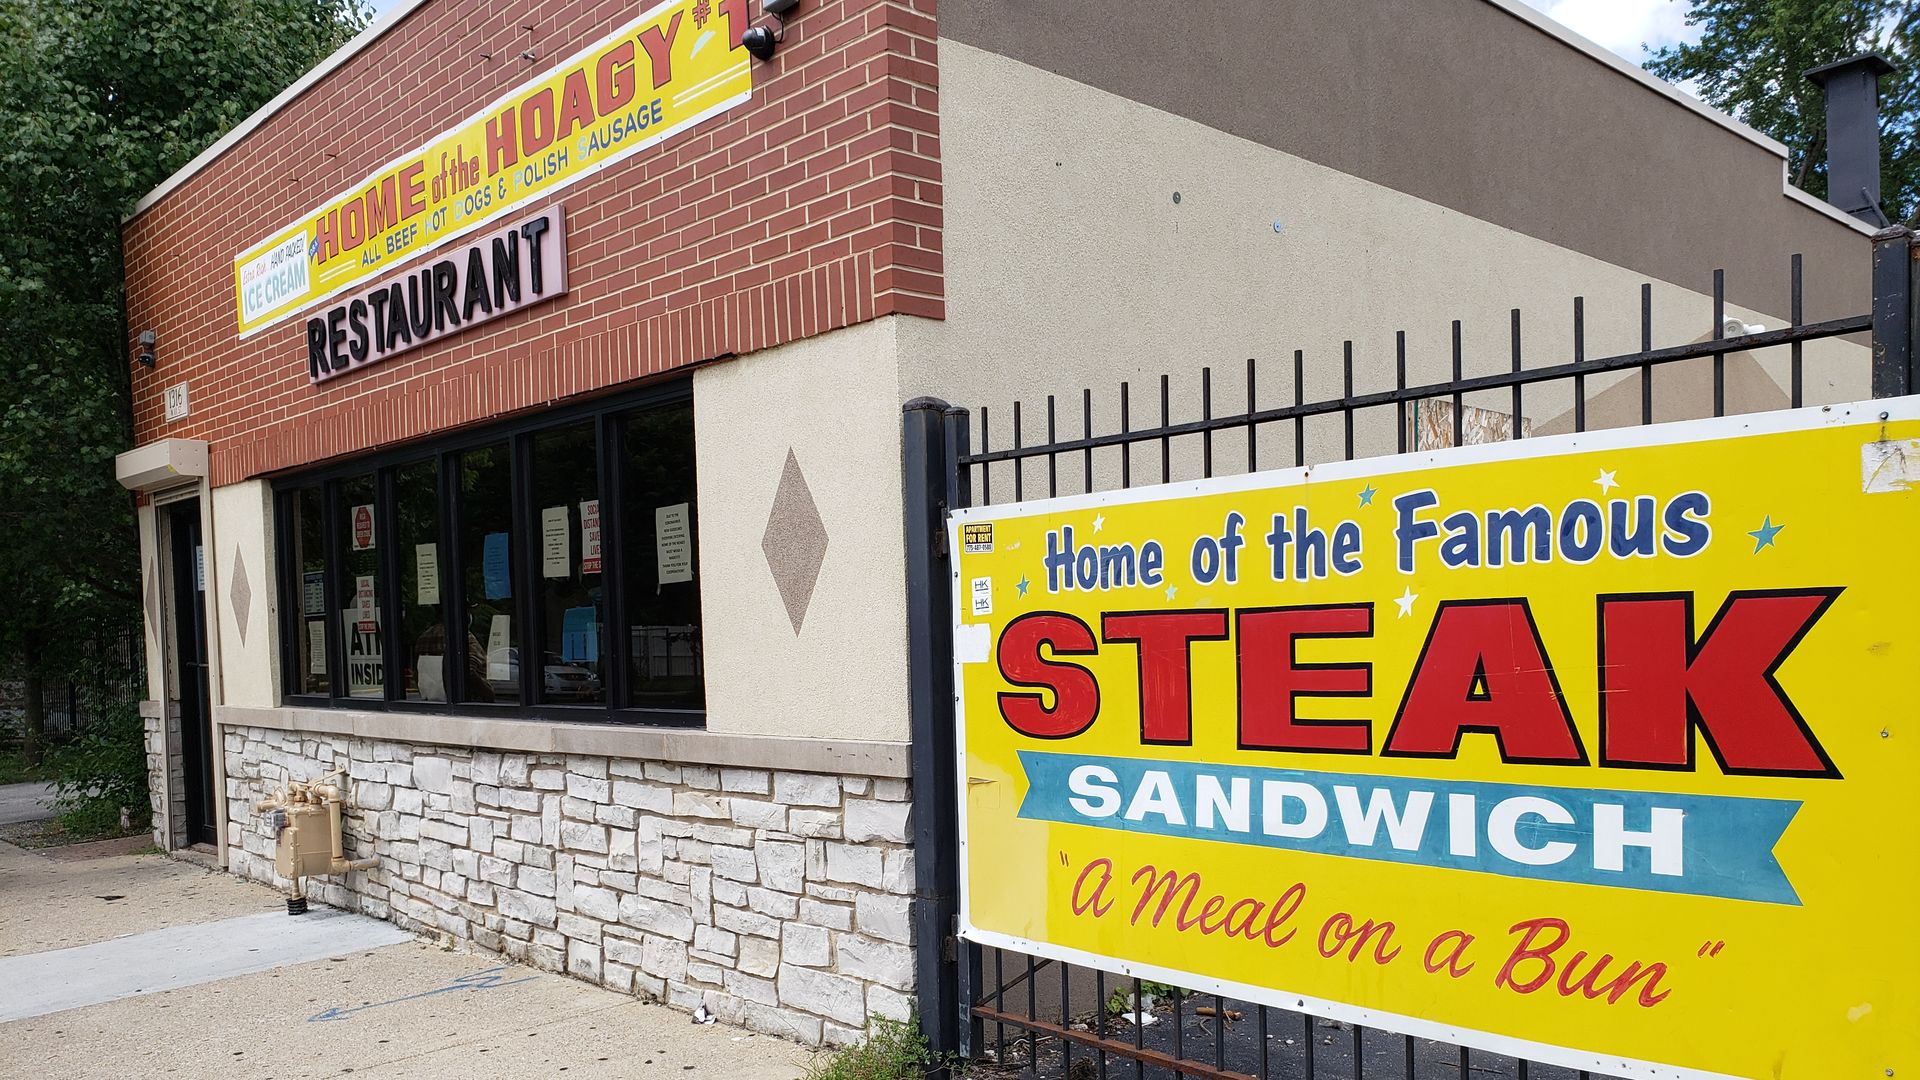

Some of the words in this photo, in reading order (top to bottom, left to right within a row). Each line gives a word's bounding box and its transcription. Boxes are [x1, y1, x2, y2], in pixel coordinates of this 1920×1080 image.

[316, 160, 427, 265] HOME
[431, 151, 448, 204] of
[450, 144, 480, 195] the
[485, 9, 684, 179] HOAGY
[361, 243, 381, 268] ALL
[386, 223, 418, 257] BEEF
[424, 206, 448, 237] HOT
[454, 184, 492, 221] DOGS
[498, 177, 507, 200] &
[513, 146, 568, 192] POLISH
[577, 98, 663, 161] SAUSAGE
[244, 283, 262, 315] ICE
[264, 257, 306, 304] CREAM
[270, 248, 284, 271] HAND
[307, 216, 549, 378] RESTAURANT
[168, 386, 183, 409] 1316
[965, 533, 977, 543] FOR
[977, 532, 991, 542] RENT
[974, 579, 989, 589] HK
[1044, 525, 1164, 594] Home
[1190, 510, 1246, 585] of
[1265, 506, 1364, 581] the
[1392, 487, 1712, 576] Famous
[975, 597, 989, 608] HK
[997, 587, 1847, 780] STEAK
[1067, 764, 1683, 877] SANDWICH
[1131, 864, 1306, 948] Meal
[1317, 912, 1402, 965] on
[1423, 929, 1476, 978] a
